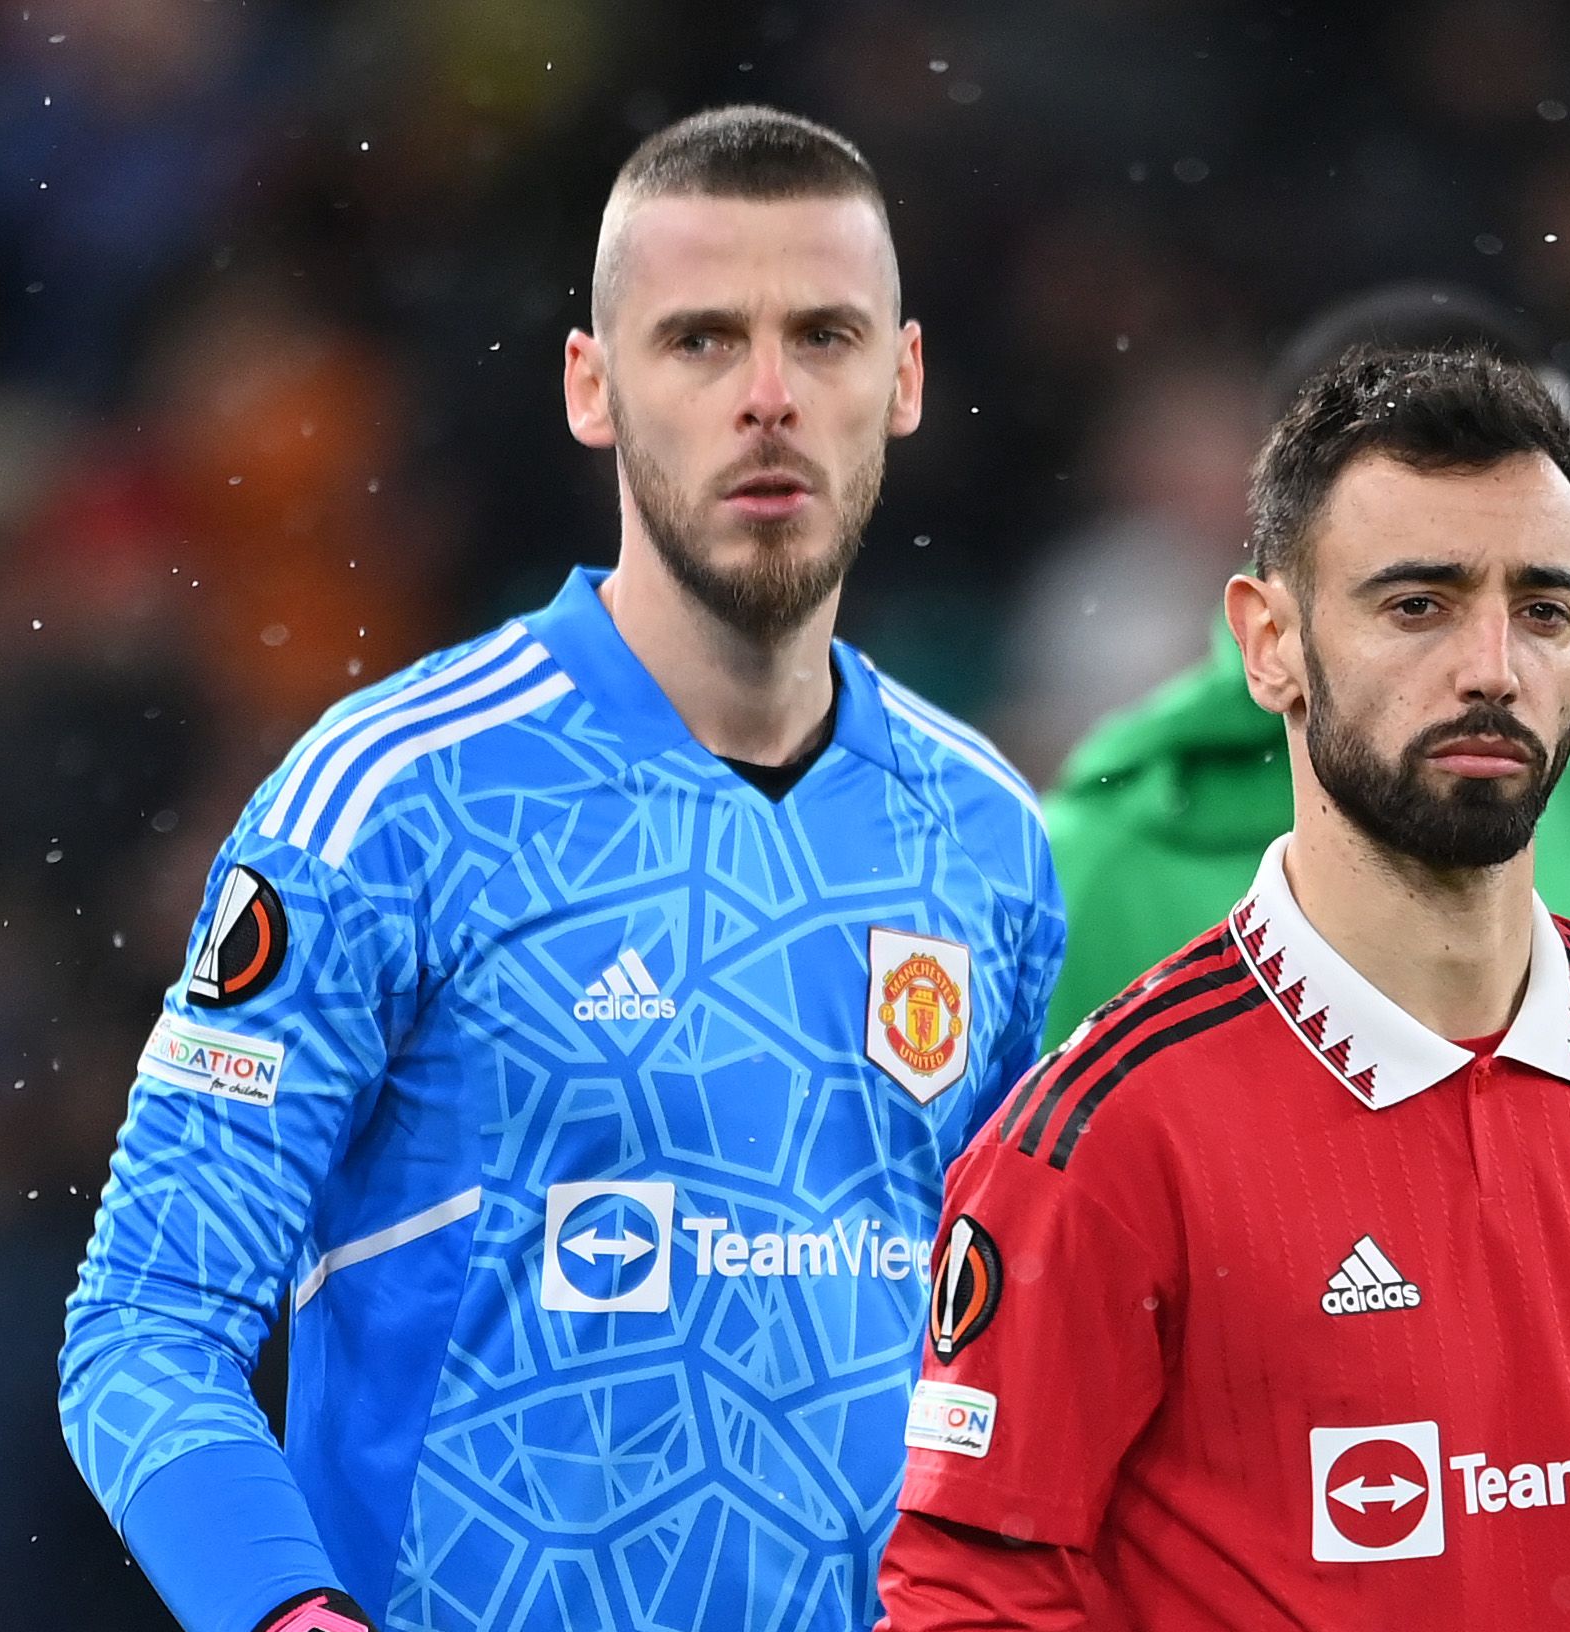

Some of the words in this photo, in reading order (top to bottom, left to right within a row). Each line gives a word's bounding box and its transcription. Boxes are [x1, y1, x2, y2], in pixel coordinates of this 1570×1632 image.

[889, 961, 956, 1008] MANCHESTER
[574, 995, 676, 1021] adidas
[899, 1045, 945, 1069] UNITED
[1322, 1283, 1421, 1315] adidas
